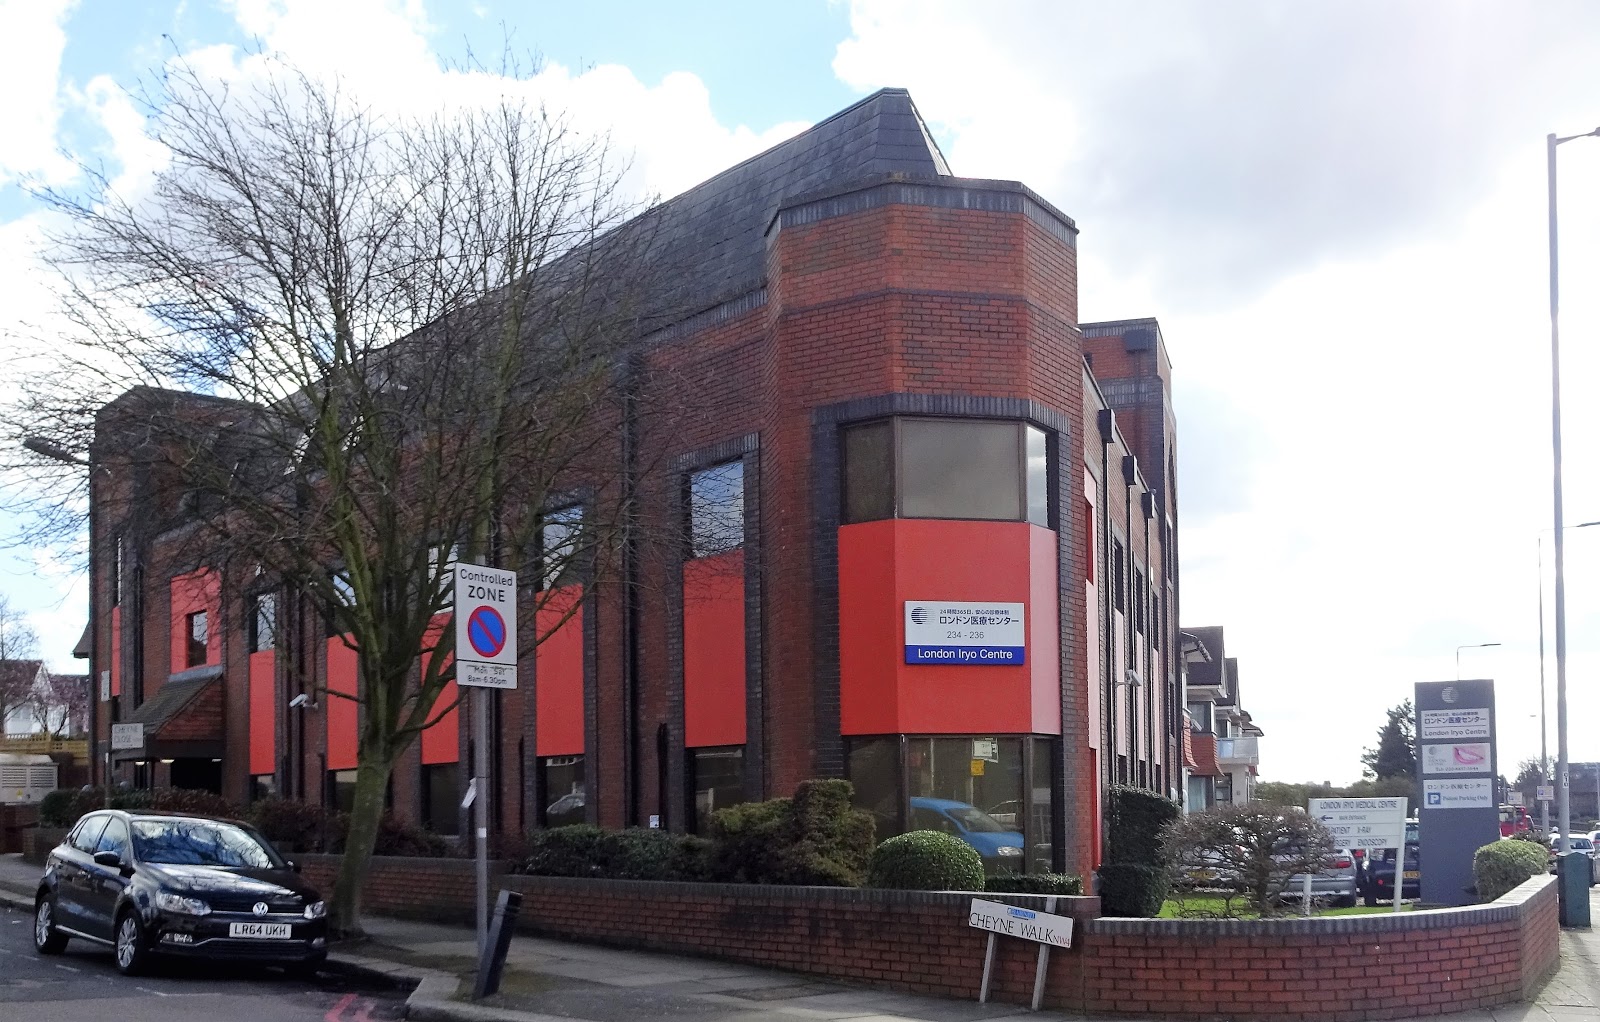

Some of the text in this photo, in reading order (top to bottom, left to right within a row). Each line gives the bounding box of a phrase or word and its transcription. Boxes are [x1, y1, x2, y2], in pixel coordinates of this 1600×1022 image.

[460, 568, 513, 586] Controlled
[467, 585, 506, 602] ZONE
[940, 616, 1019, 625] ロンドン医療センター
[946, 631, 962, 639] 234
[969, 631, 985, 640] 236
[918, 648, 1013, 661] London Iryo Centre
[1320, 801, 1341, 810] LONDON
[1343, 801, 1354, 809] IRYO
[1356, 801, 1376, 809] MEDICAL
[1357, 826, 1371, 834] X-RAY
[1335, 839, 1351, 847] RGERY
[234, 924, 286, 936] LR64 UKH
[969, 912, 1015, 934] CHEYNE
[1020, 922, 1054, 943] WALK
